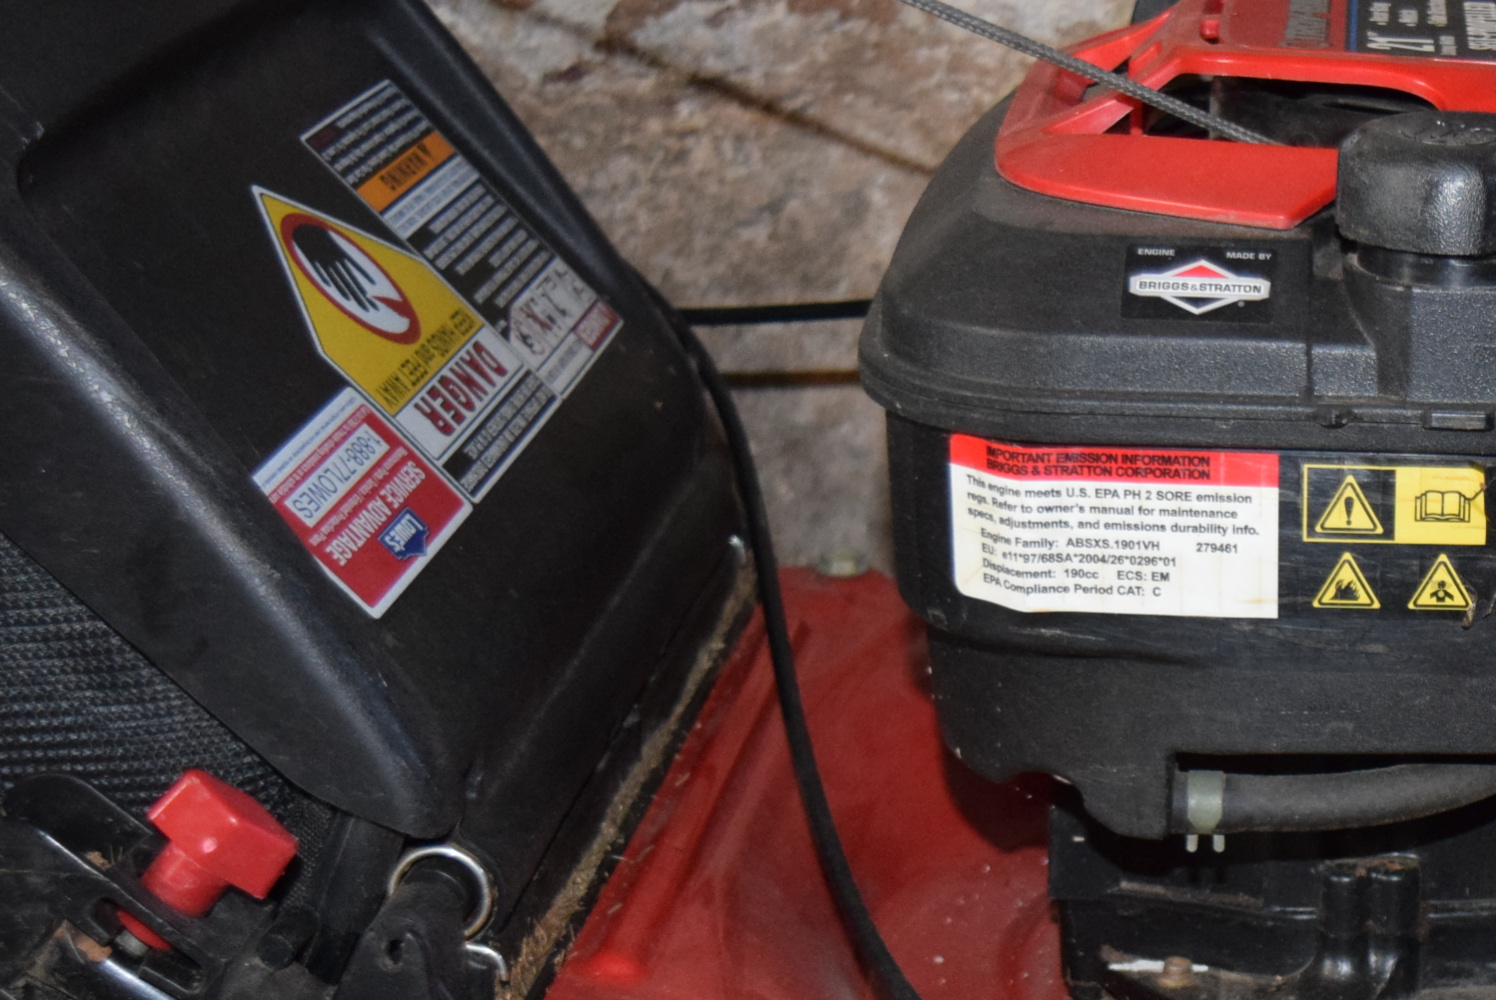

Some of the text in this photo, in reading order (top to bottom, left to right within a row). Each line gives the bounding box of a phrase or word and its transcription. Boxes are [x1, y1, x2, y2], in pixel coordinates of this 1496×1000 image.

[1137, 248, 1176, 257] ENGINE
[1226, 251, 1272, 260] MADE BY
[426, 324, 457, 358] HANDS
[397, 359, 429, 387] FEET
[376, 371, 411, 408] AWAY
[413, 340, 508, 437] DANGER
[986, 445, 1210, 467] IMPORTANT EMISSION INFORMATION
[986, 459, 1211, 480] BRIGGS & STRATTON CORPORATION
[293, 430, 384, 519] 1-888-77LOWES
[966, 474, 1252, 504] This engine meets U.S. EPA PH 2 SORE emission
[325, 461, 426, 567] SERVICE ADVANTAGE
[967, 491, 1238, 519] regs. Refer to owner's manual for maintenance
[384, 513, 424, 553] LOWE'S
[999, 515, 1074, 530] adjustments,
[1078, 520, 1100, 530] and
[1104, 521, 1166, 533] emissions
[1170, 523, 1228, 536] durability
[1232, 524, 1260, 535] info.
[980, 527, 1238, 554] Engine Family: ABSXS.1901VH 279461
[981, 543, 997, 556] EU:
[983, 558, 1170, 582] Displacement: 190cc ECS: EM
[983, 573, 1161, 597] EPA Compliance Period CAT: C
